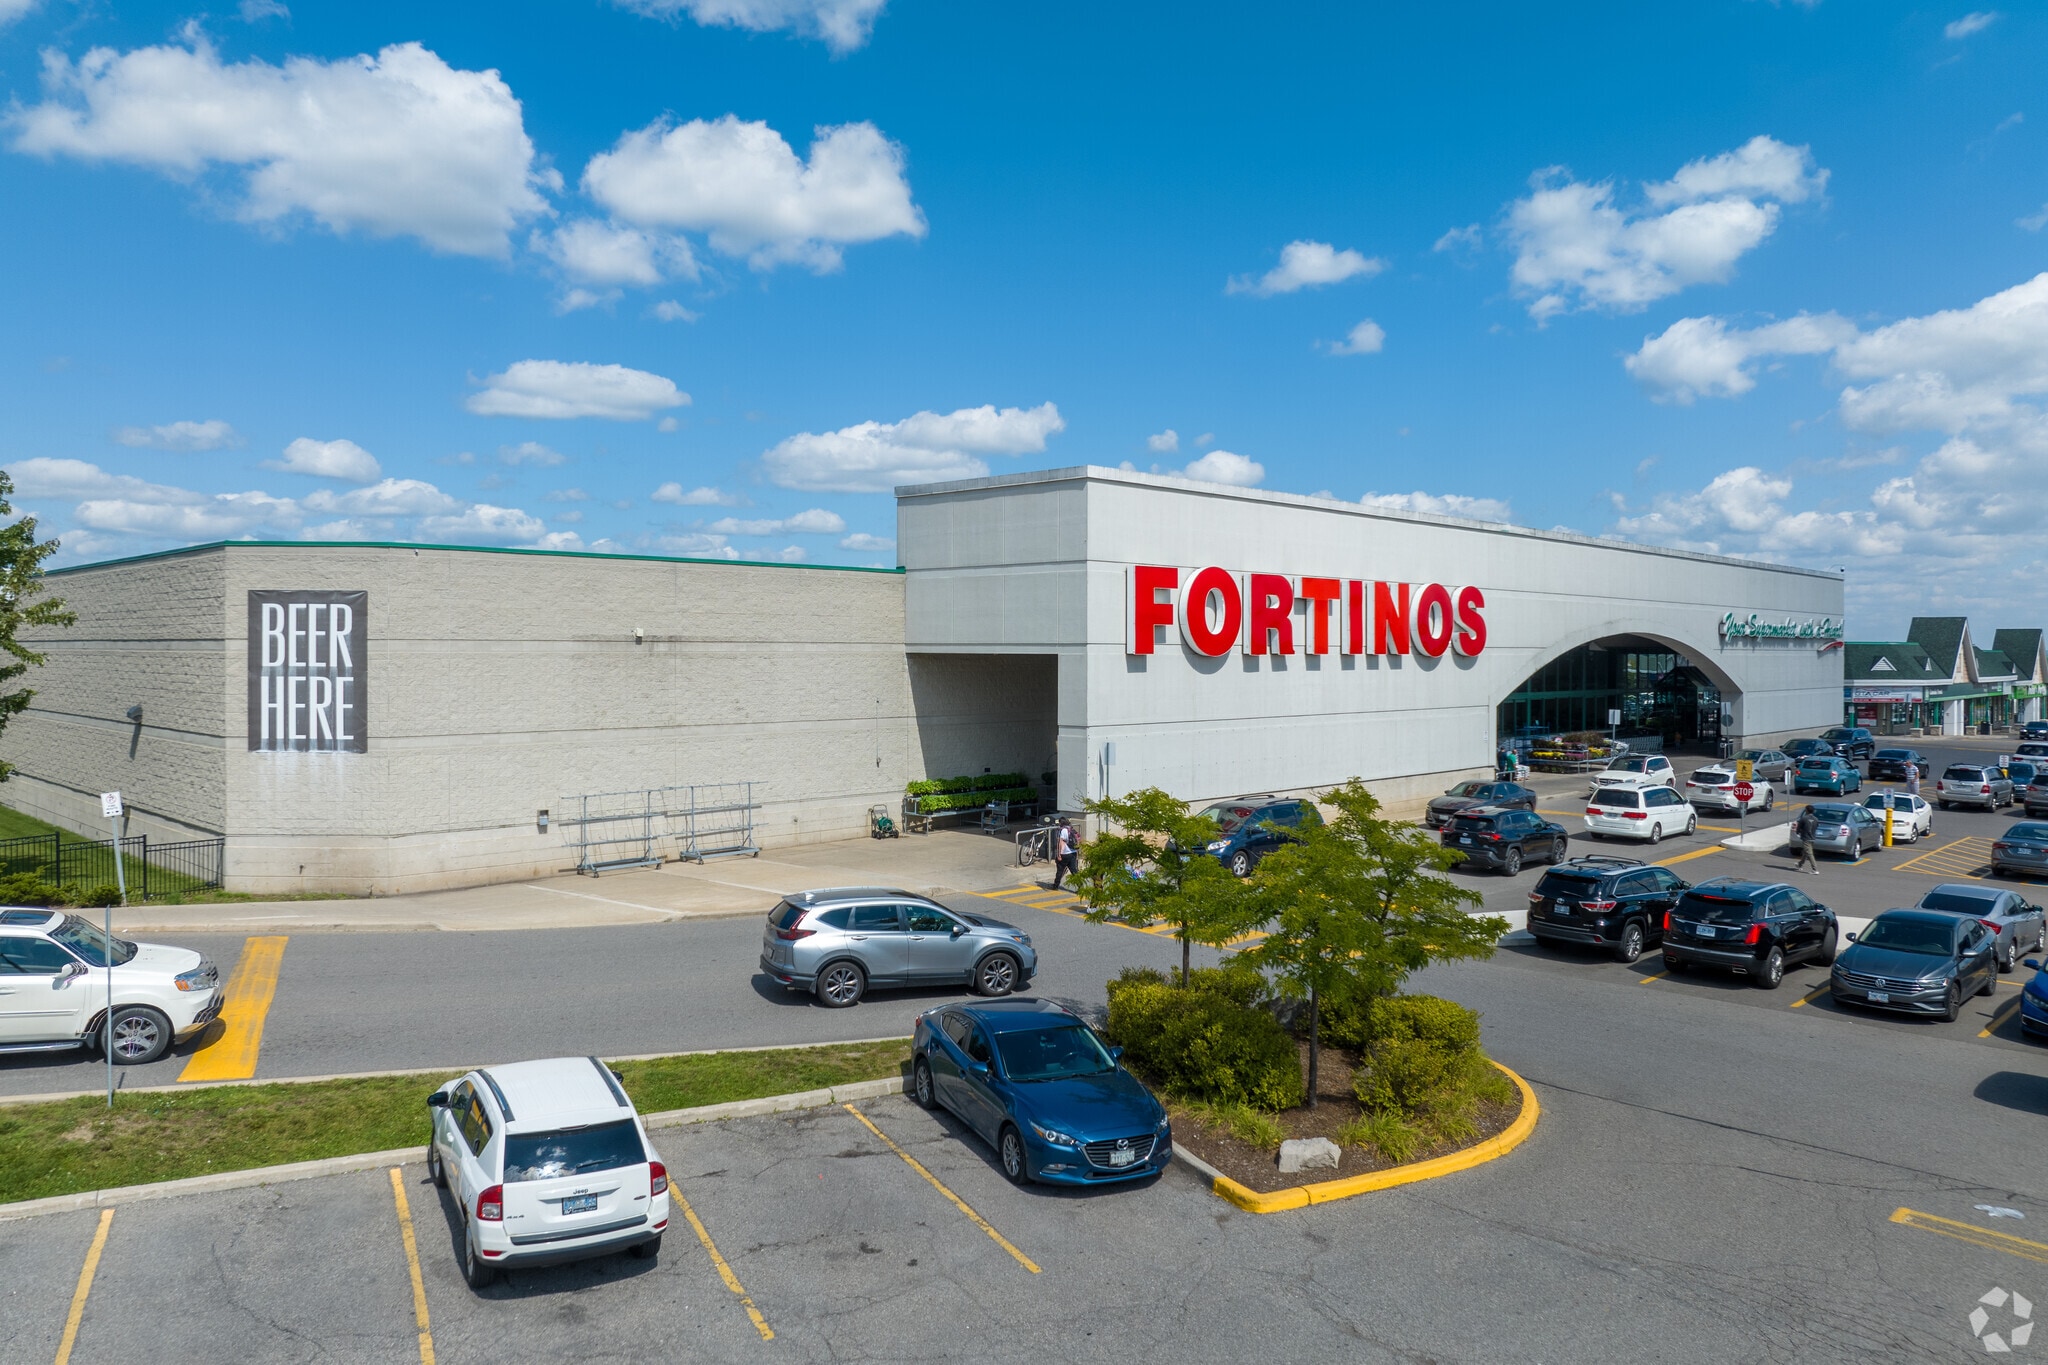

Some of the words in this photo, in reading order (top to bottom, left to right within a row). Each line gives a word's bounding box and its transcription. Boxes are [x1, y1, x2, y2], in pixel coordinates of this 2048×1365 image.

[262, 603, 353, 667] BEER
[1127, 565, 1487, 657] FORTINOS
[261, 676, 354, 740] HERE
[1734, 787, 1753, 796] STOP
